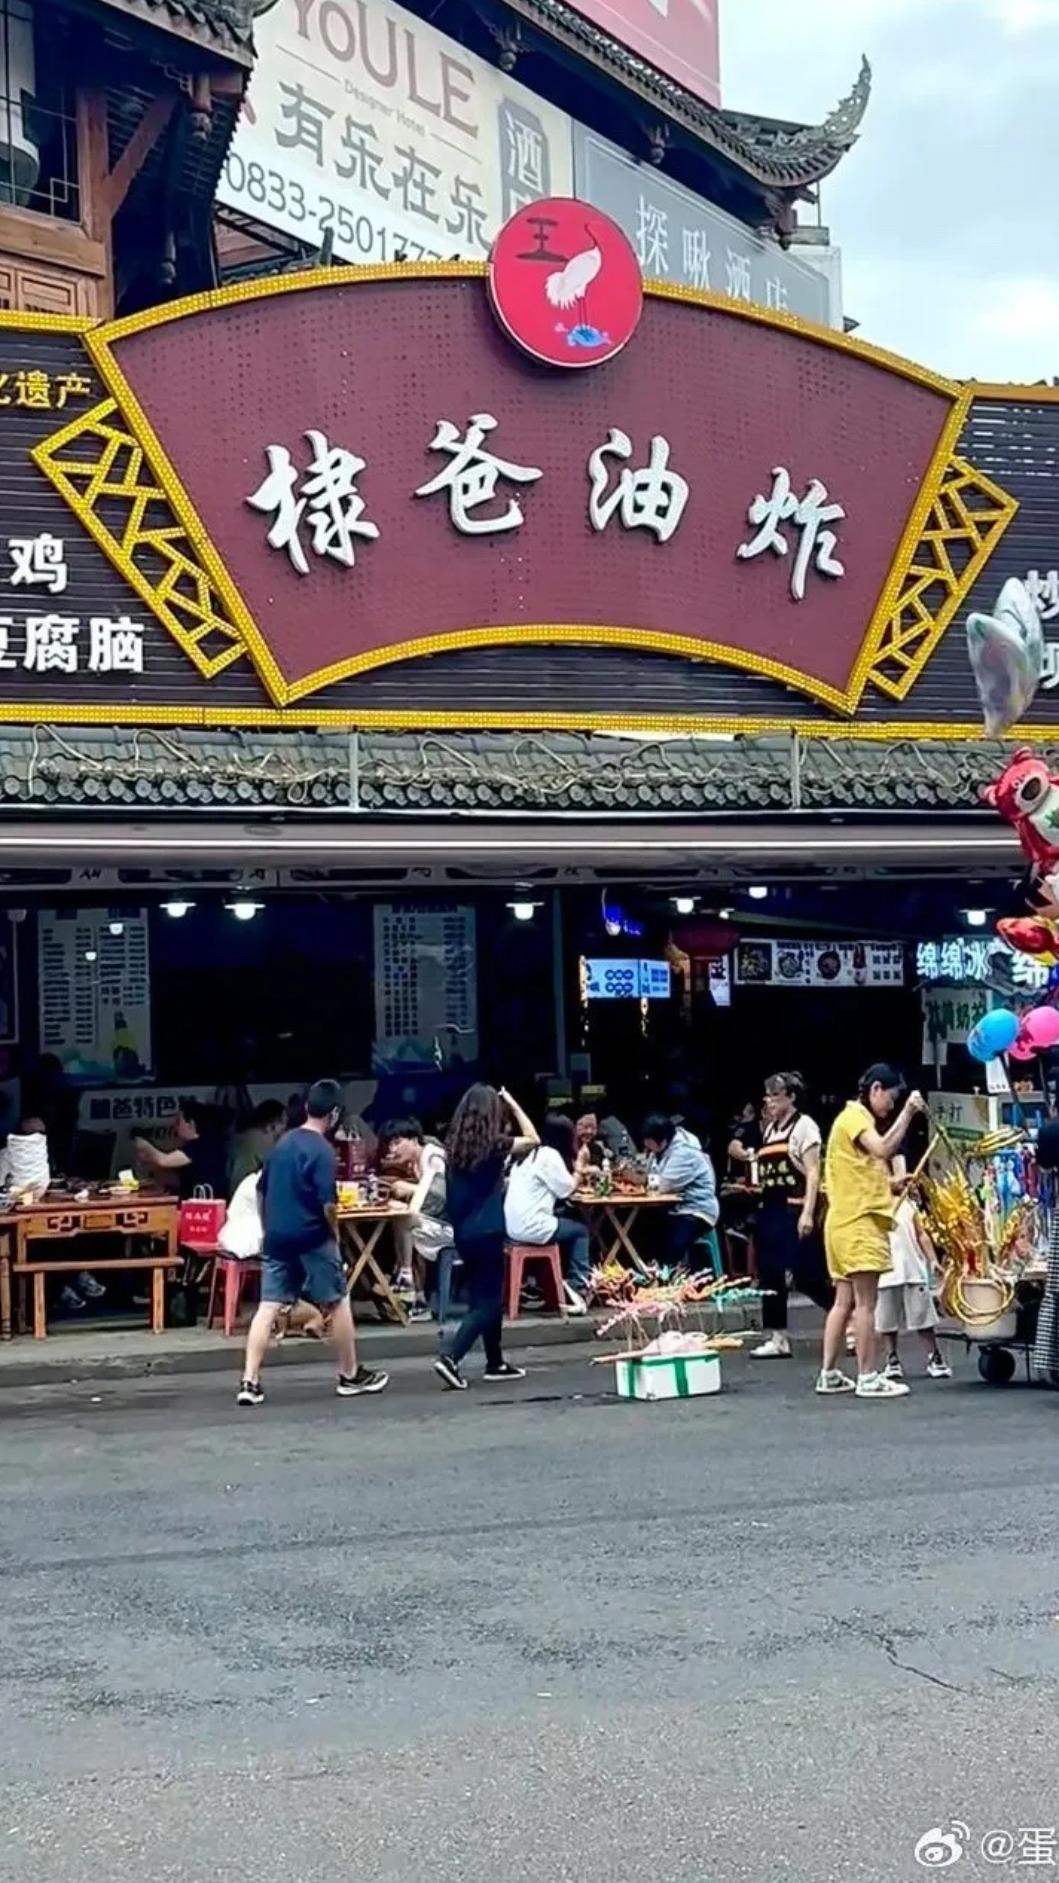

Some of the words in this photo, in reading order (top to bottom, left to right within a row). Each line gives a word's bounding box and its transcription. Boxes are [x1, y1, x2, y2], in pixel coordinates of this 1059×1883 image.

[274, 81, 492, 252] 有乐在乐
[8, 532, 68, 594] 鸡
[246, 413, 845, 600] 棣爸油炸
